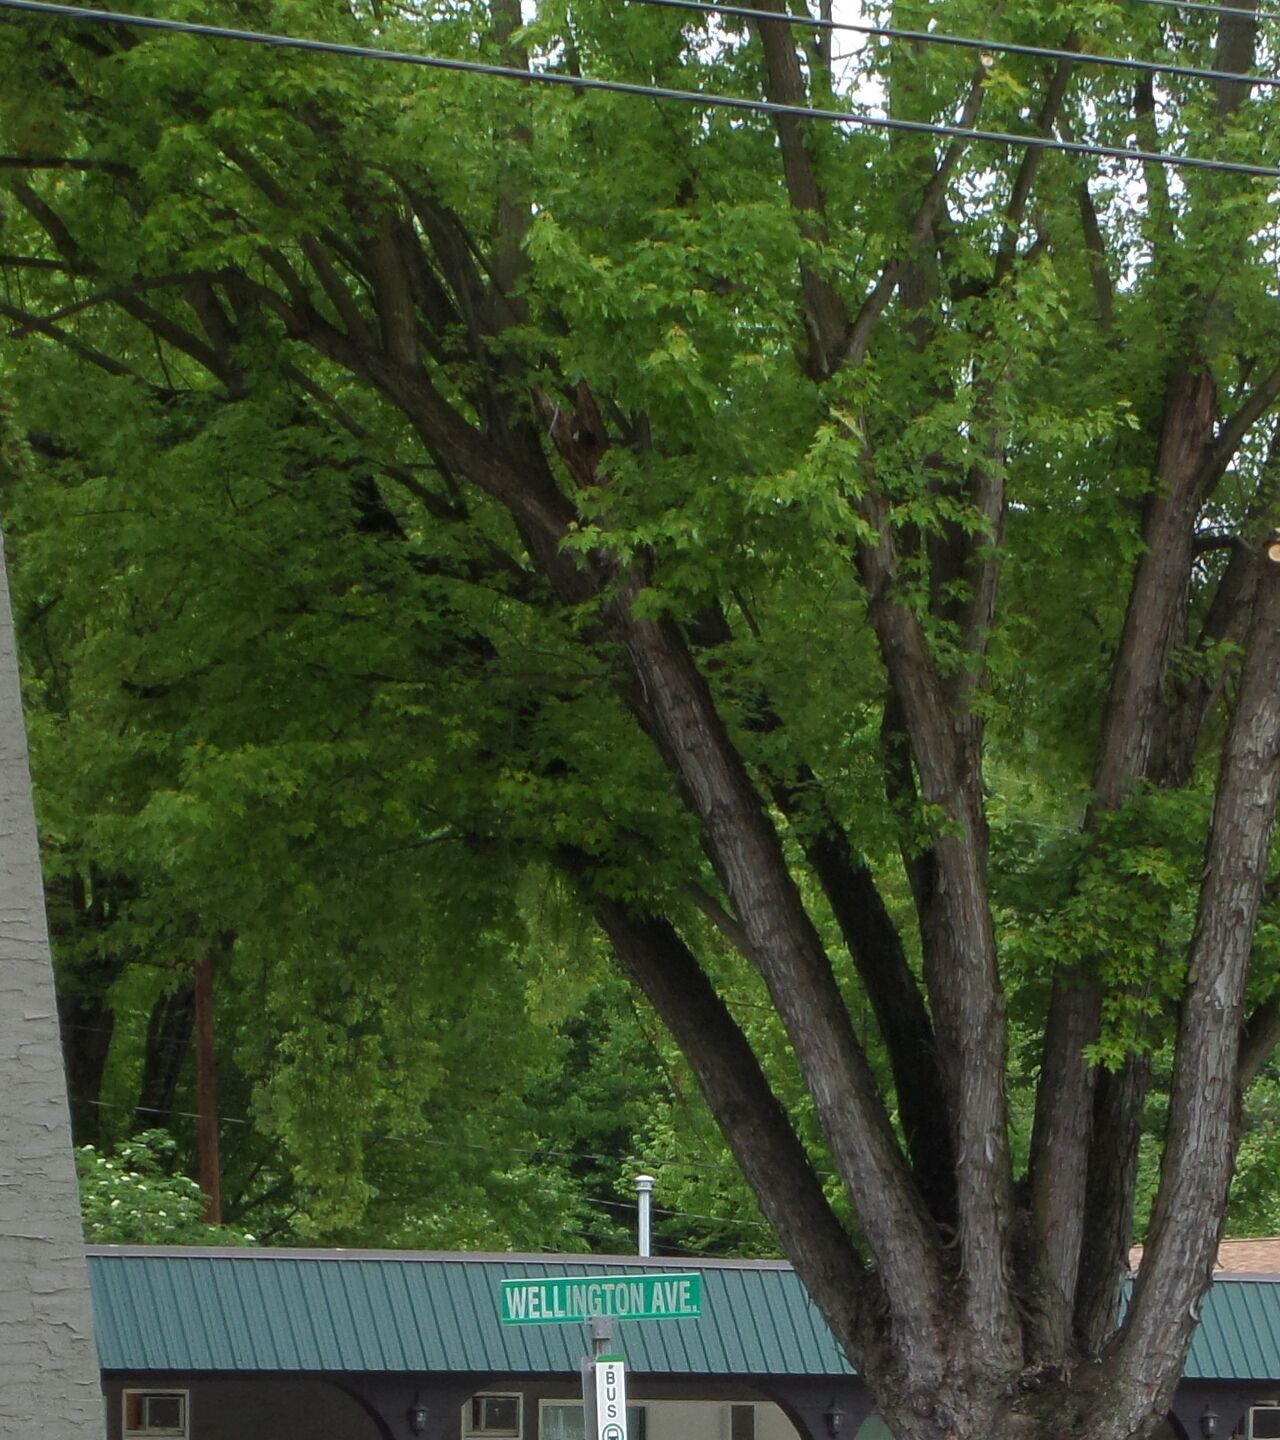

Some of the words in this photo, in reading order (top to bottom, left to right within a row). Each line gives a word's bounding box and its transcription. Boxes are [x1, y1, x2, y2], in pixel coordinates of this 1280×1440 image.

[505, 1282, 645, 1319] WELLINGTON
[651, 1280, 697, 1314] AVE.
[605, 1371, 617, 1419] BUS
